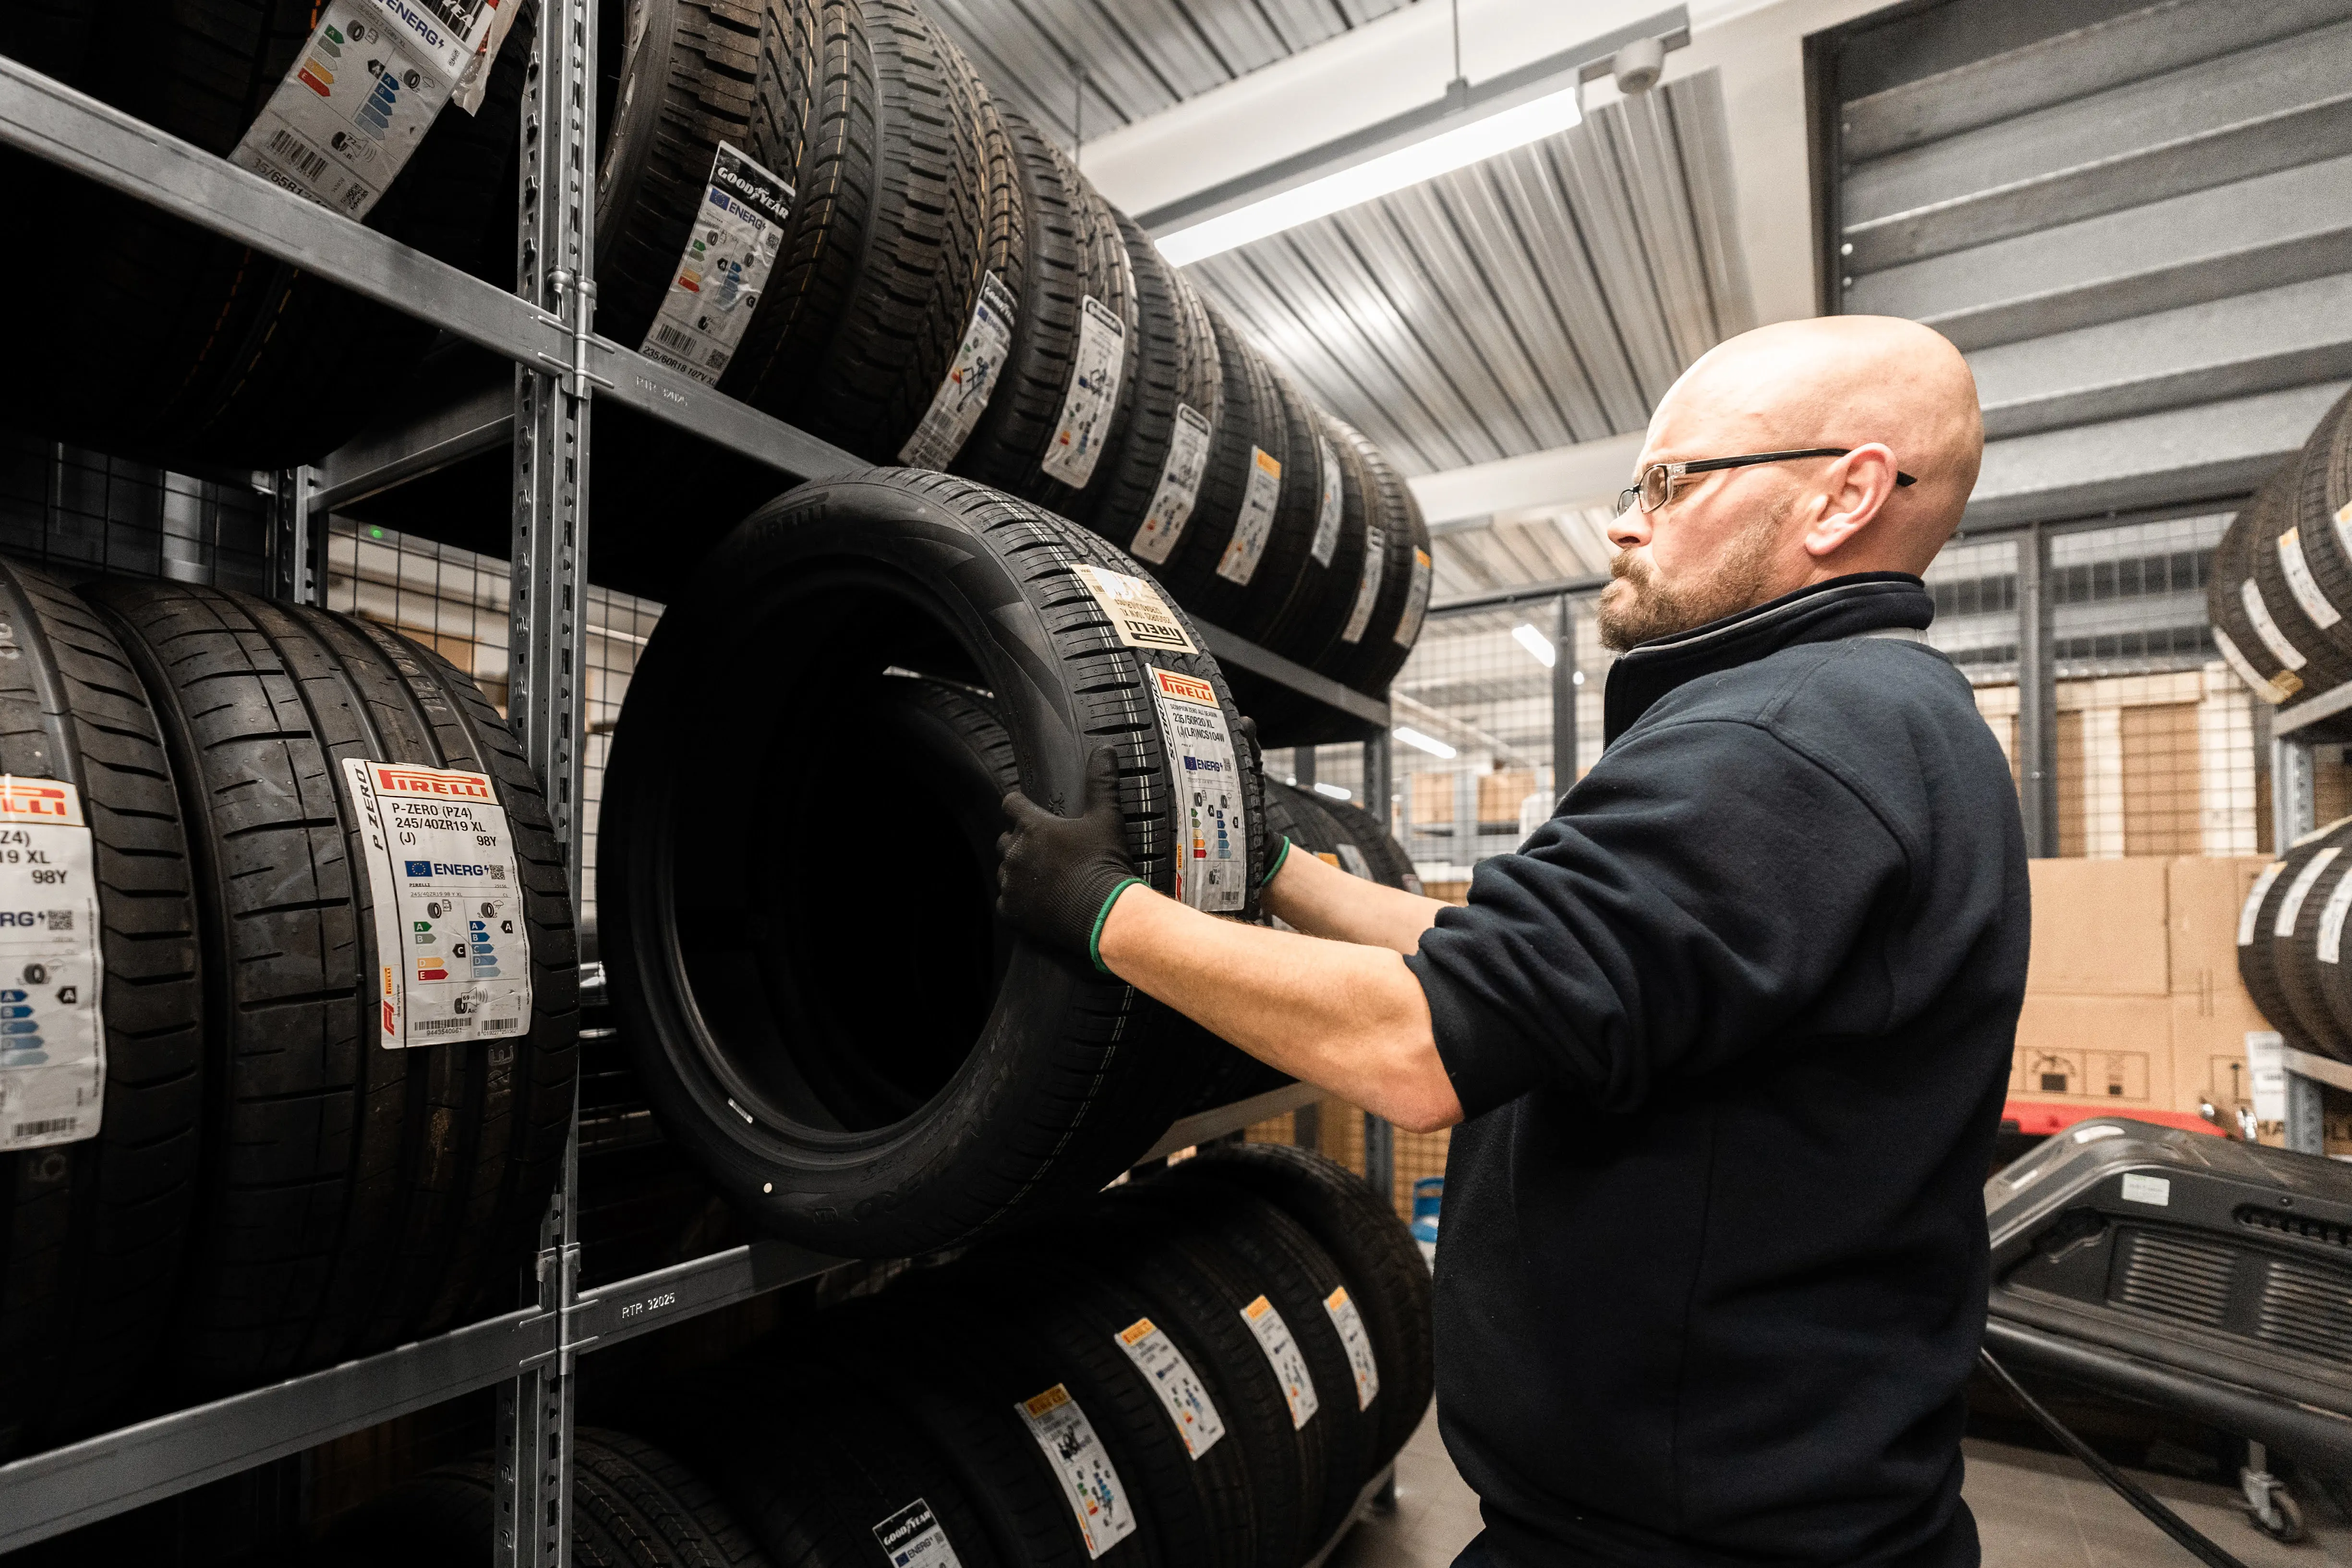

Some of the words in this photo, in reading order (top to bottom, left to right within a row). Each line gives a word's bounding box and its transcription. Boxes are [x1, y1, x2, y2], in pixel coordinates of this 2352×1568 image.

[386, 0, 439, 46] ENERG
[347, 135, 357, 145] 72
[717, 167, 789, 219] GOODYEAR
[728, 201, 763, 230] ENERG
[1124, 620, 1189, 647] PIRELLI
[1158, 673, 1214, 702] PIRELLI
[1207, 720, 1215, 729] XL
[1197, 759, 1220, 772] ENERG
[377, 769, 489, 798] PIRELLI
[355, 768, 379, 829] ZERO
[392, 803, 438, 816] P-ZERO
[442, 807, 472, 820] (PZ4)
[395, 818, 468, 832] 245/40ZR19
[471, 821, 486, 832] XL
[373, 834, 384, 851] P
[399, 832, 416, 845] (J)
[476, 835, 496, 846] 98Y
[27, 849, 50, 864] XL
[32, 869, 68, 884] 98Y
[434, 863, 483, 876] ENERG
[621, 1302, 643, 1318] RTR
[647, 1293, 675, 1311] 32025
[883, 1510, 931, 1545] GOODYEAR
